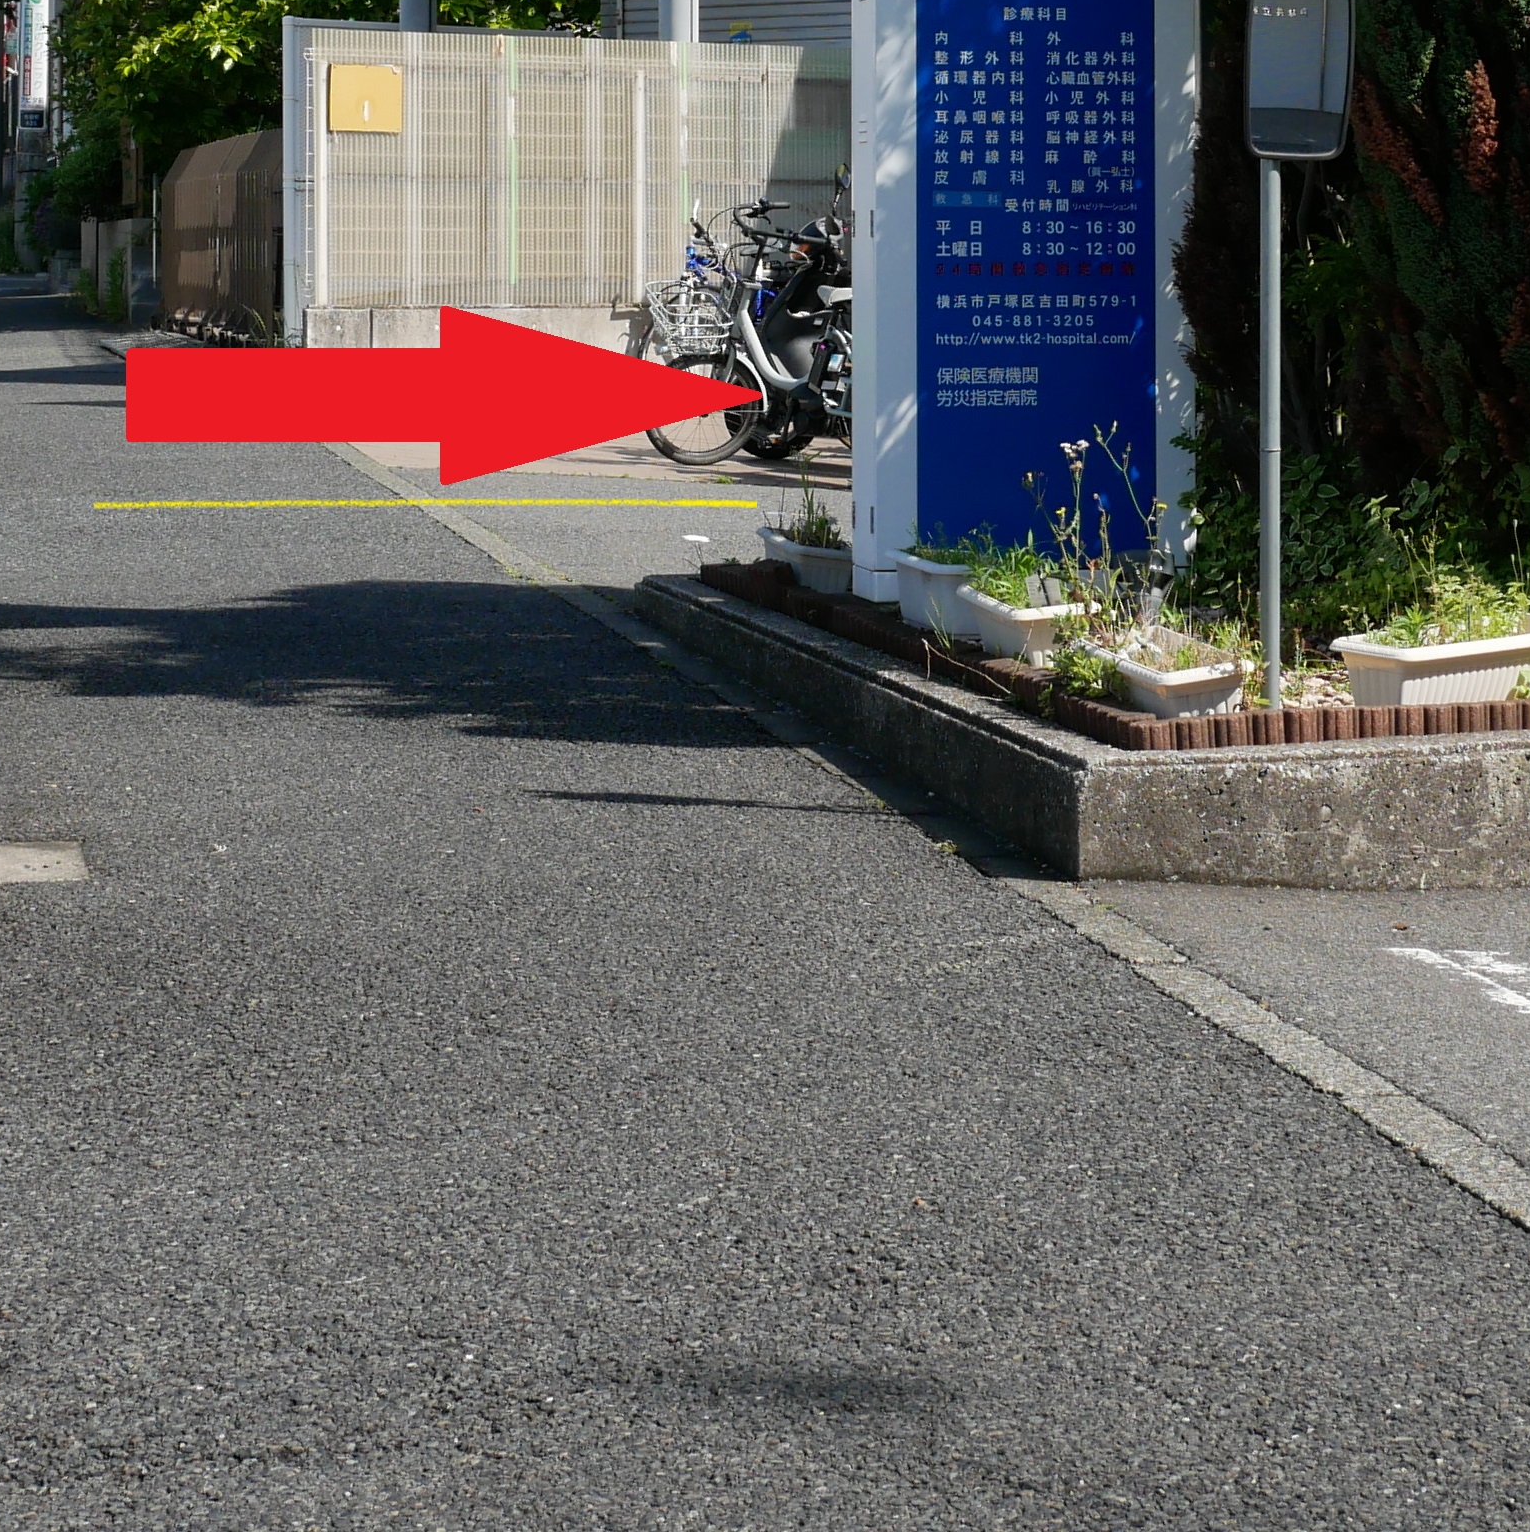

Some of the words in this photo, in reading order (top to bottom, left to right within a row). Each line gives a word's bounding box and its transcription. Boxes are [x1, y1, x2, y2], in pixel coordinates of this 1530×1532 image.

[1003, 7, 1067, 21] 診療科目
[935, 31, 1024, 45] 内科
[1046, 31, 1135, 46] 外科
[934, 50, 1024, 65] 整形外科
[1046, 50, 1135, 65] 消化器外科
[934, 70, 1024, 85] 循環器内科
[1046, 70, 1136, 85] 心臓血管外科
[935, 90, 1024, 105] 小児科
[1045, 90, 1135, 105] 小児外科
[934, 110, 1024, 125] 耳鼻咽喉科
[1046, 110, 1135, 125] 呼吸器外科
[934, 130, 1024, 144] 泌尿器科
[1046, 130, 1135, 145] 脳神経外科
[934, 149, 1024, 164] 放射線科
[1045, 149, 1136, 164] 麻酔科
[934, 170, 1025, 185] 皮膚科
[1046, 179, 1134, 193] 乳腺外科
[1005, 198, 1070, 213] 受付時間
[1072, 202, 1138, 212] リハビリテーション科
[936, 220, 983, 236] 平日
[936, 241, 983, 257] 土曜日
[972, 315, 1094, 327] 045-881-3205
[936, 332, 1135, 347] http://www.tk2-hospital.com/
[936, 367, 1038, 385] 保険医療機関
[936, 389, 1038, 407] 労災指定病院
